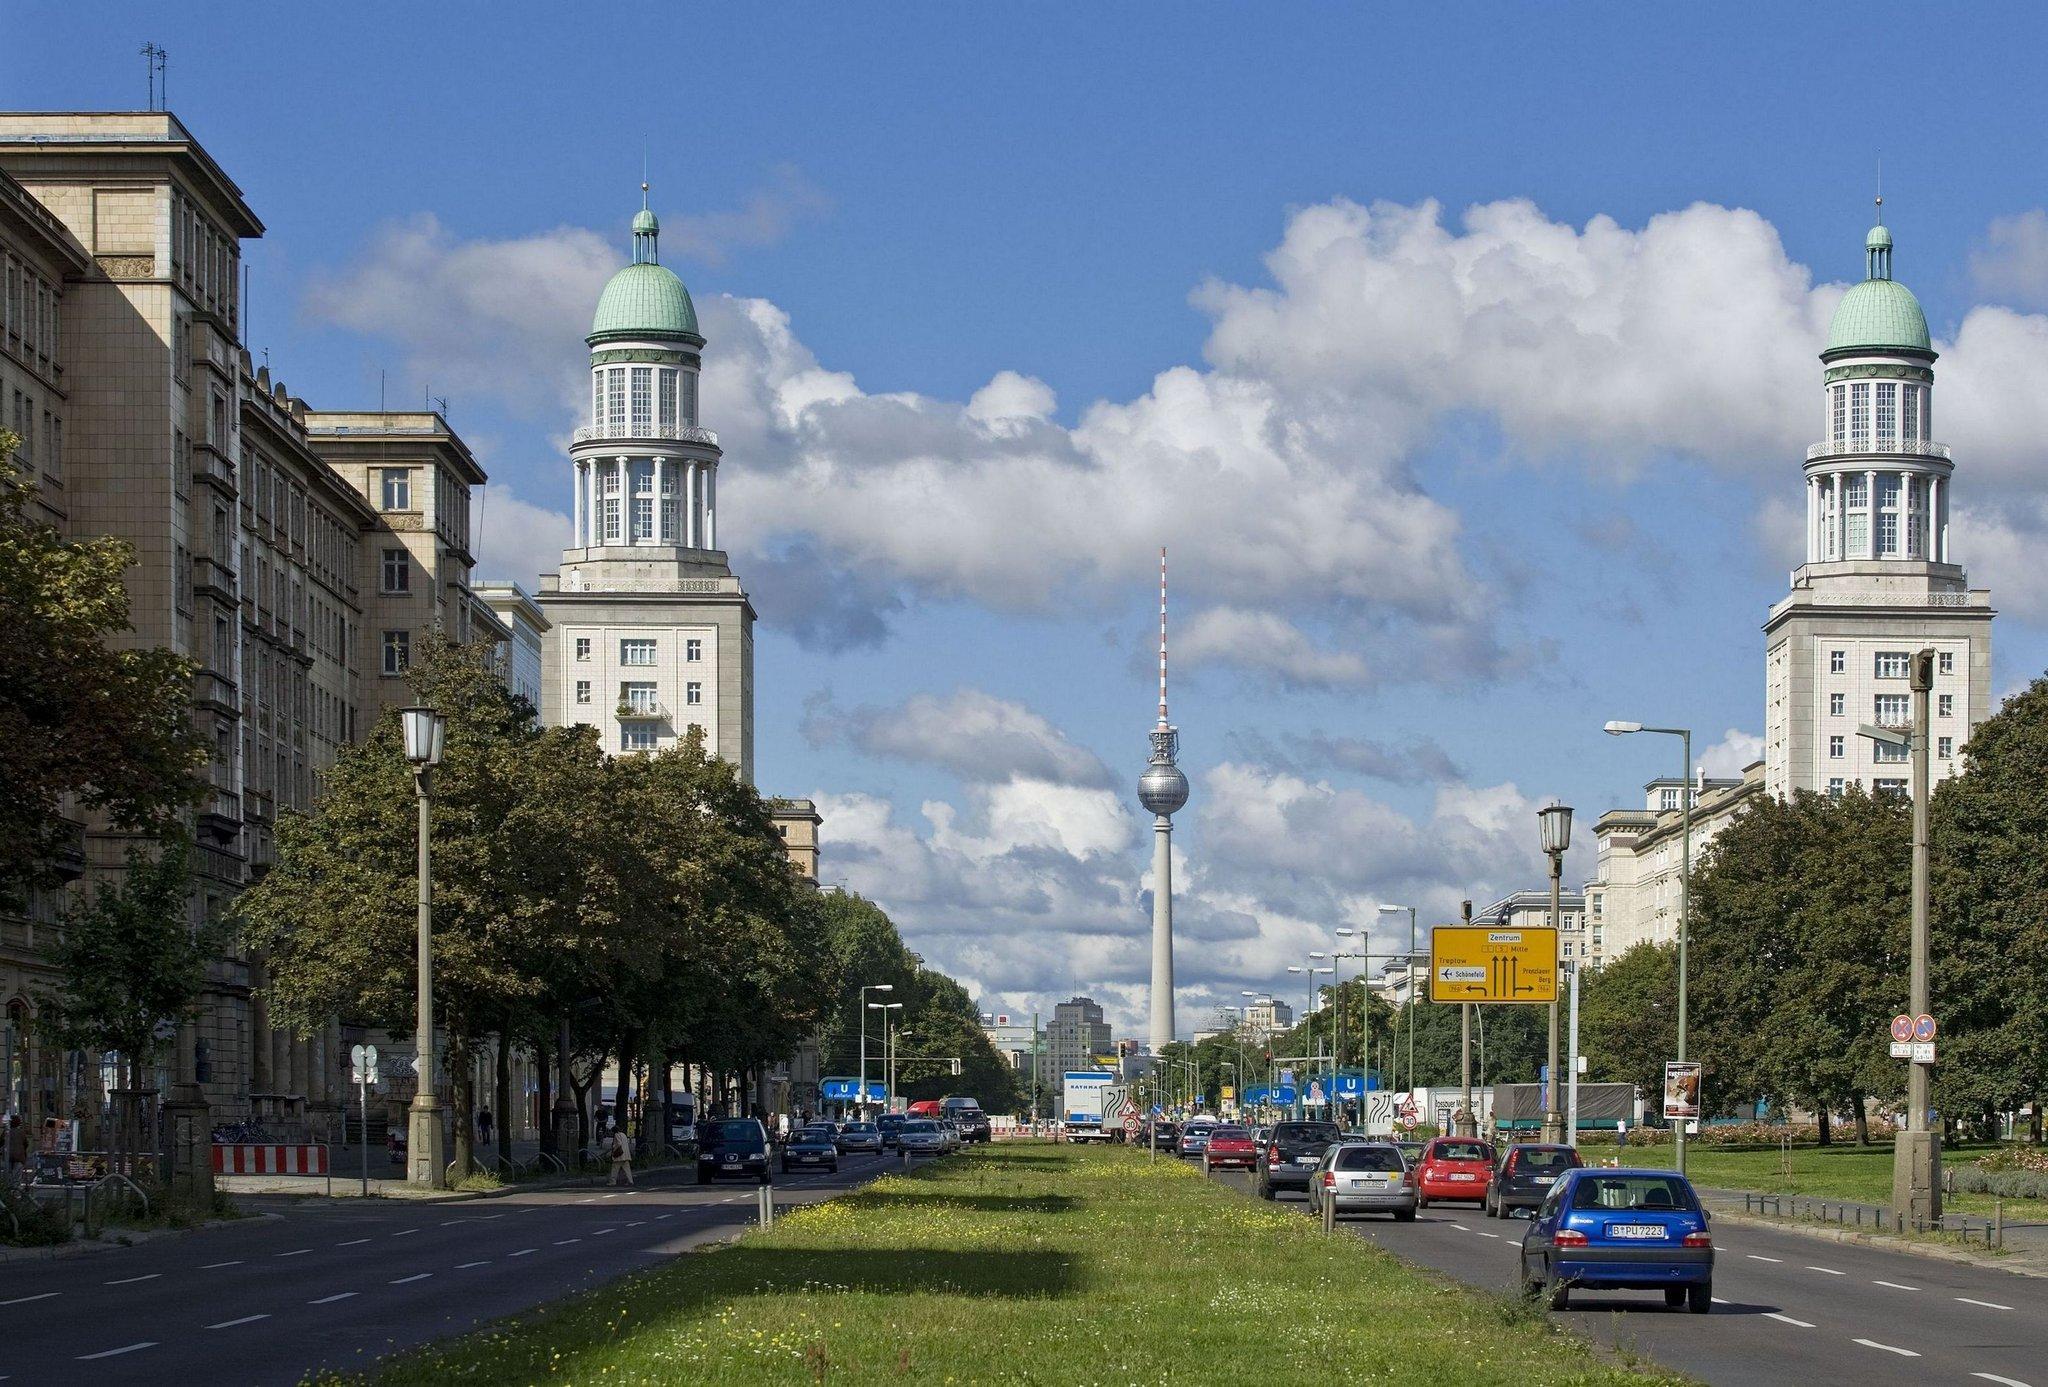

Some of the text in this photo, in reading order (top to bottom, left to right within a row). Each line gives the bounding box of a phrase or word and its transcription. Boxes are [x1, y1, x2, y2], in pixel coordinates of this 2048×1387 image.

[1439, 957, 1467, 965] Treptow
[1347, 1079, 1356, 1089] U
[840, 1084, 848, 1093] U
[1272, 1090, 1280, 1098] U
[1406, 1117, 1413, 1125] 30
[1613, 1226, 1662, 1236] B PU 7223
